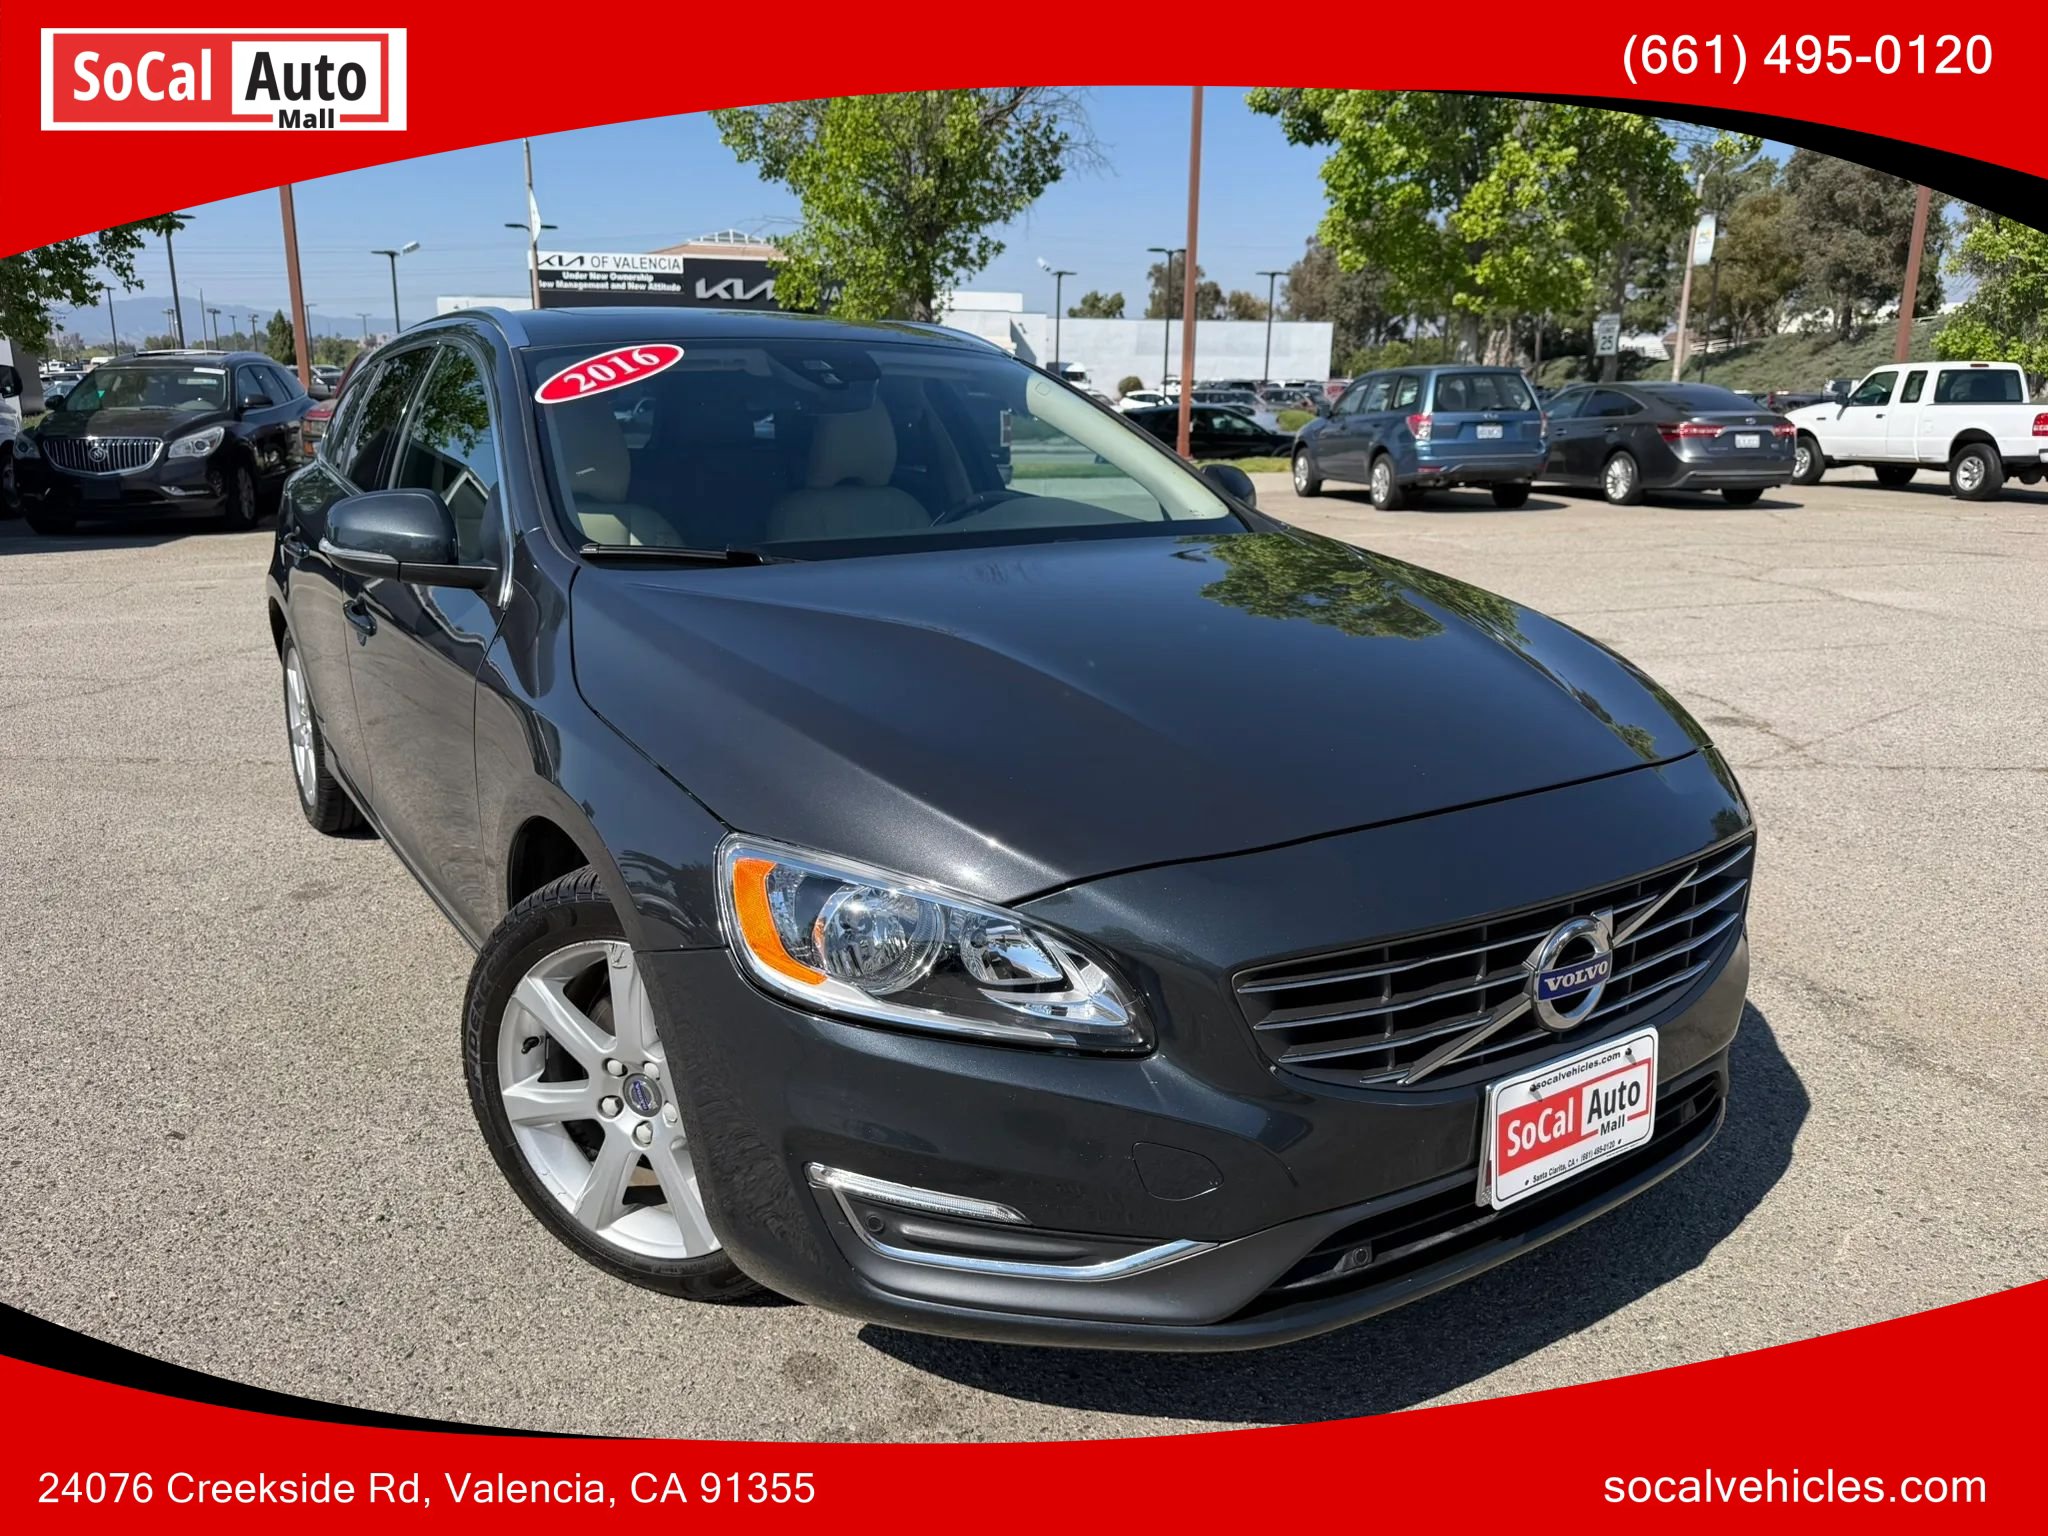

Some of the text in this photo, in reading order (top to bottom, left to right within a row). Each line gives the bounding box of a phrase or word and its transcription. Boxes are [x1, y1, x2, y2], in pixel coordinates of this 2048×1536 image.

[591, 255, 608, 269] OF
[613, 256, 681, 270] VALENCIA
[556, 280, 609, 290] Management
[610, 281, 626, 290] and
[627, 282, 647, 290] New
[647, 282, 682, 292] Attitude
[562, 271, 654, 283] Under New Ownership
[563, 348, 661, 393] 2016
[1544, 960, 1609, 992] VOLVO
[1536, 1052, 1621, 1090] socalvehicles.com
[1507, 1079, 1641, 1157] SoCal Auto
[1600, 1114, 1625, 1137] Mall
[1532, 1171, 1548, 1183] Santa
[1567, 1158, 1576, 1168] CA
